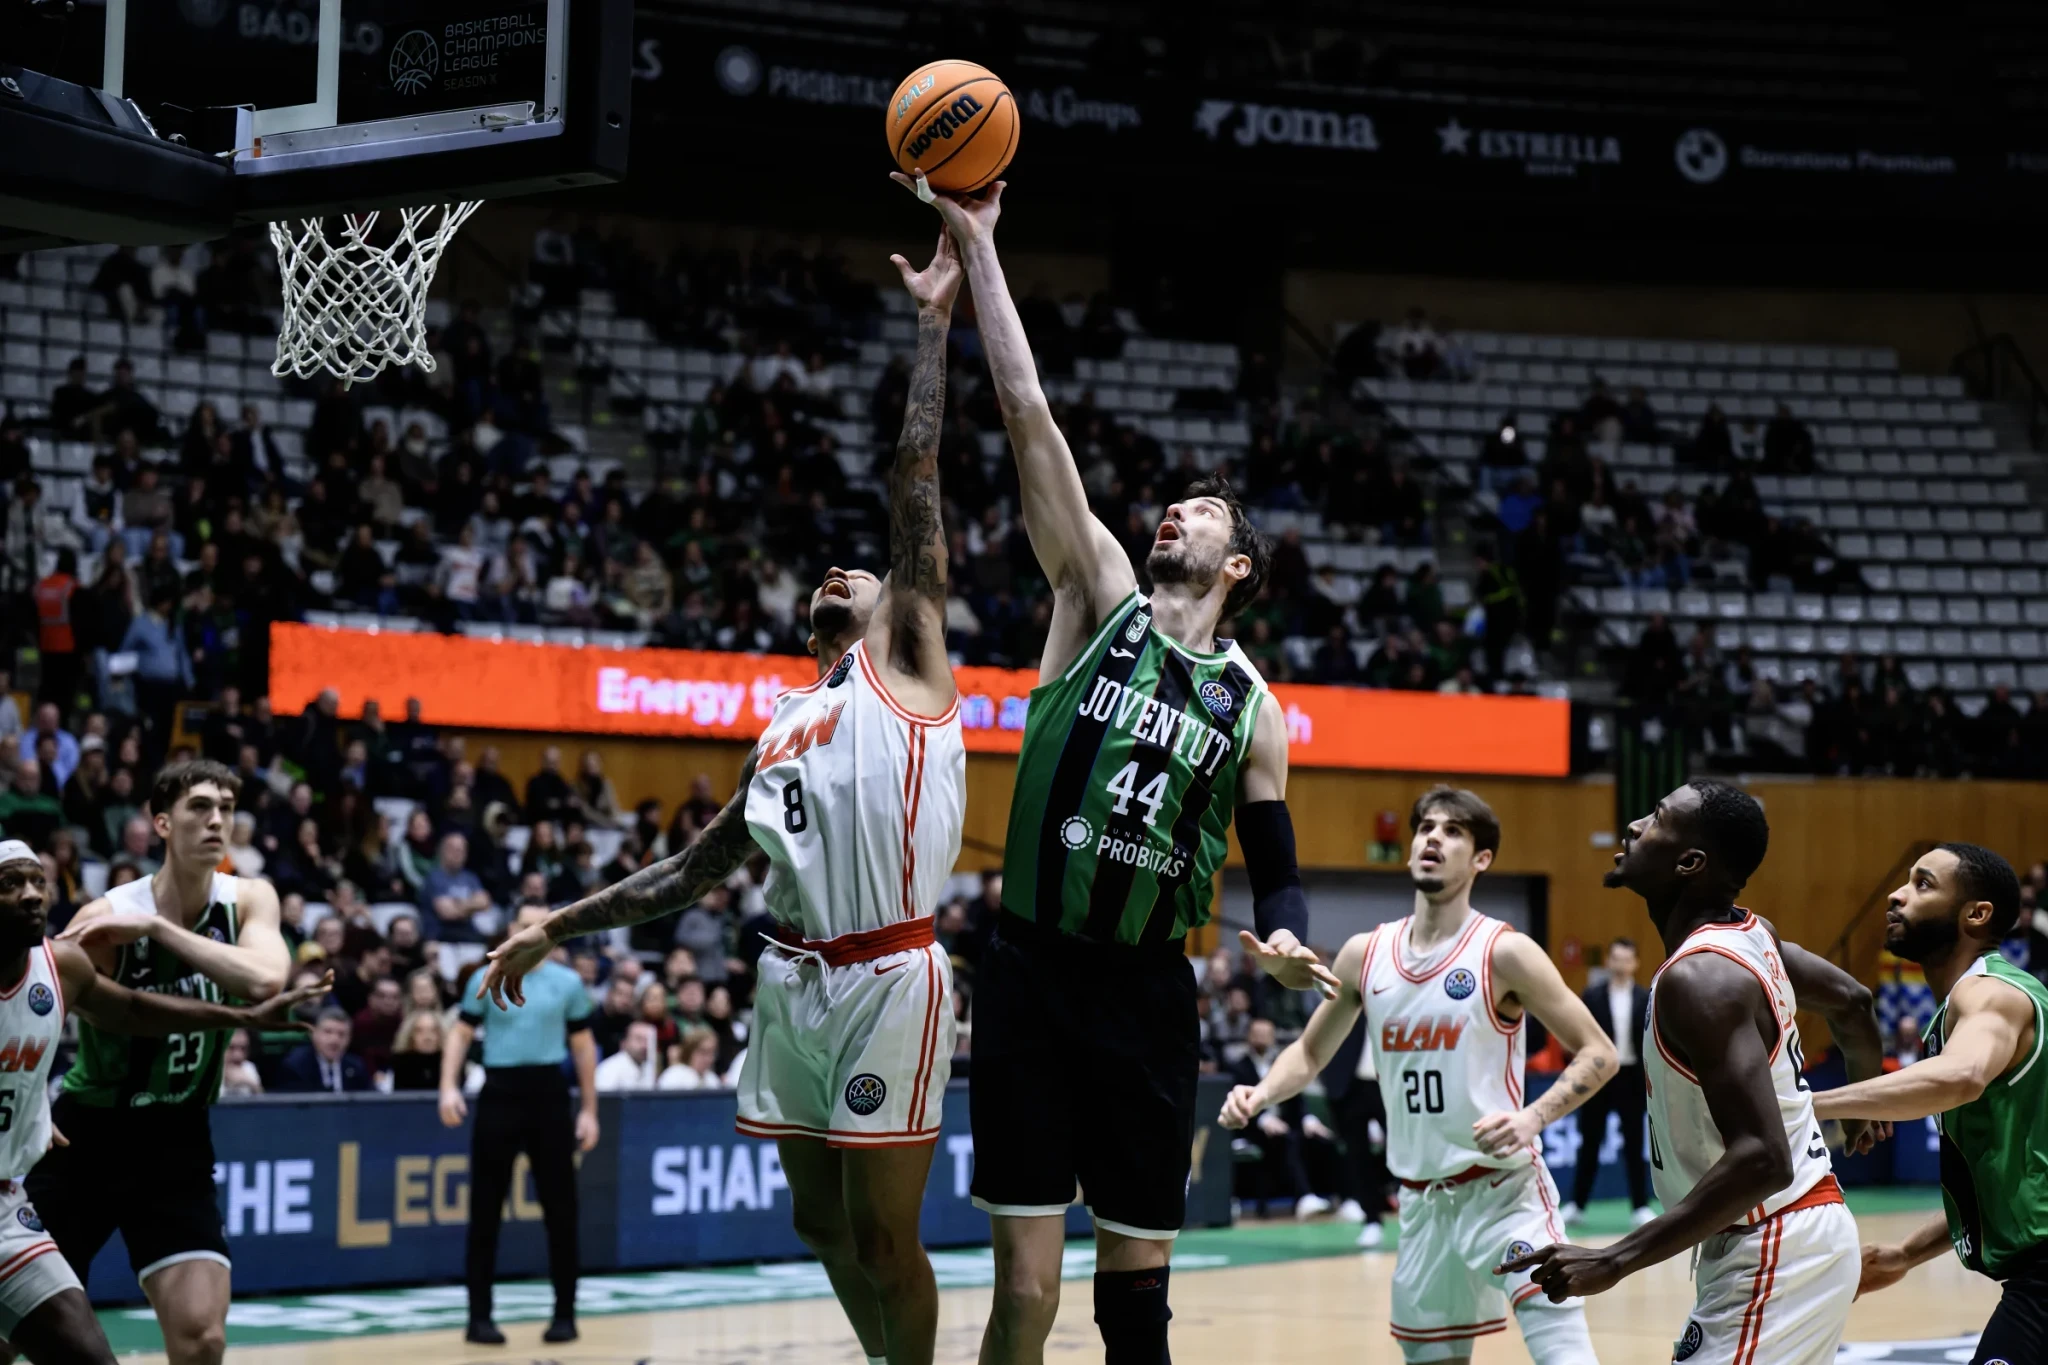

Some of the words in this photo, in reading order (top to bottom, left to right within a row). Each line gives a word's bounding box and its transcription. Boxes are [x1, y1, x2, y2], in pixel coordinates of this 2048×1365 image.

[444, 28, 546, 56] CHAMPIONS
[445, 13, 536, 38] BASKETBALL
[443, 76, 487, 91] SEASON
[444, 52, 499, 72] LEAGUE
[906, 93, 983, 160] Wilson
[1478, 128, 1622, 165] ESTRELLA
[597, 666, 746, 727] Energy
[756, 701, 847, 774] LAN
[1079, 675, 1231, 777] JOVENTUT
[783, 779, 808, 834] 8
[1106, 760, 1170, 827] 44
[1096, 834, 1185, 878] PROBITAS
[0, 1035, 50, 1073] AN
[168, 1031, 205, 1075] 23
[1382, 1015, 1469, 1051] ELAN
[1402, 1070, 1445, 1114] 20
[651, 1144, 788, 1216] SHAP
